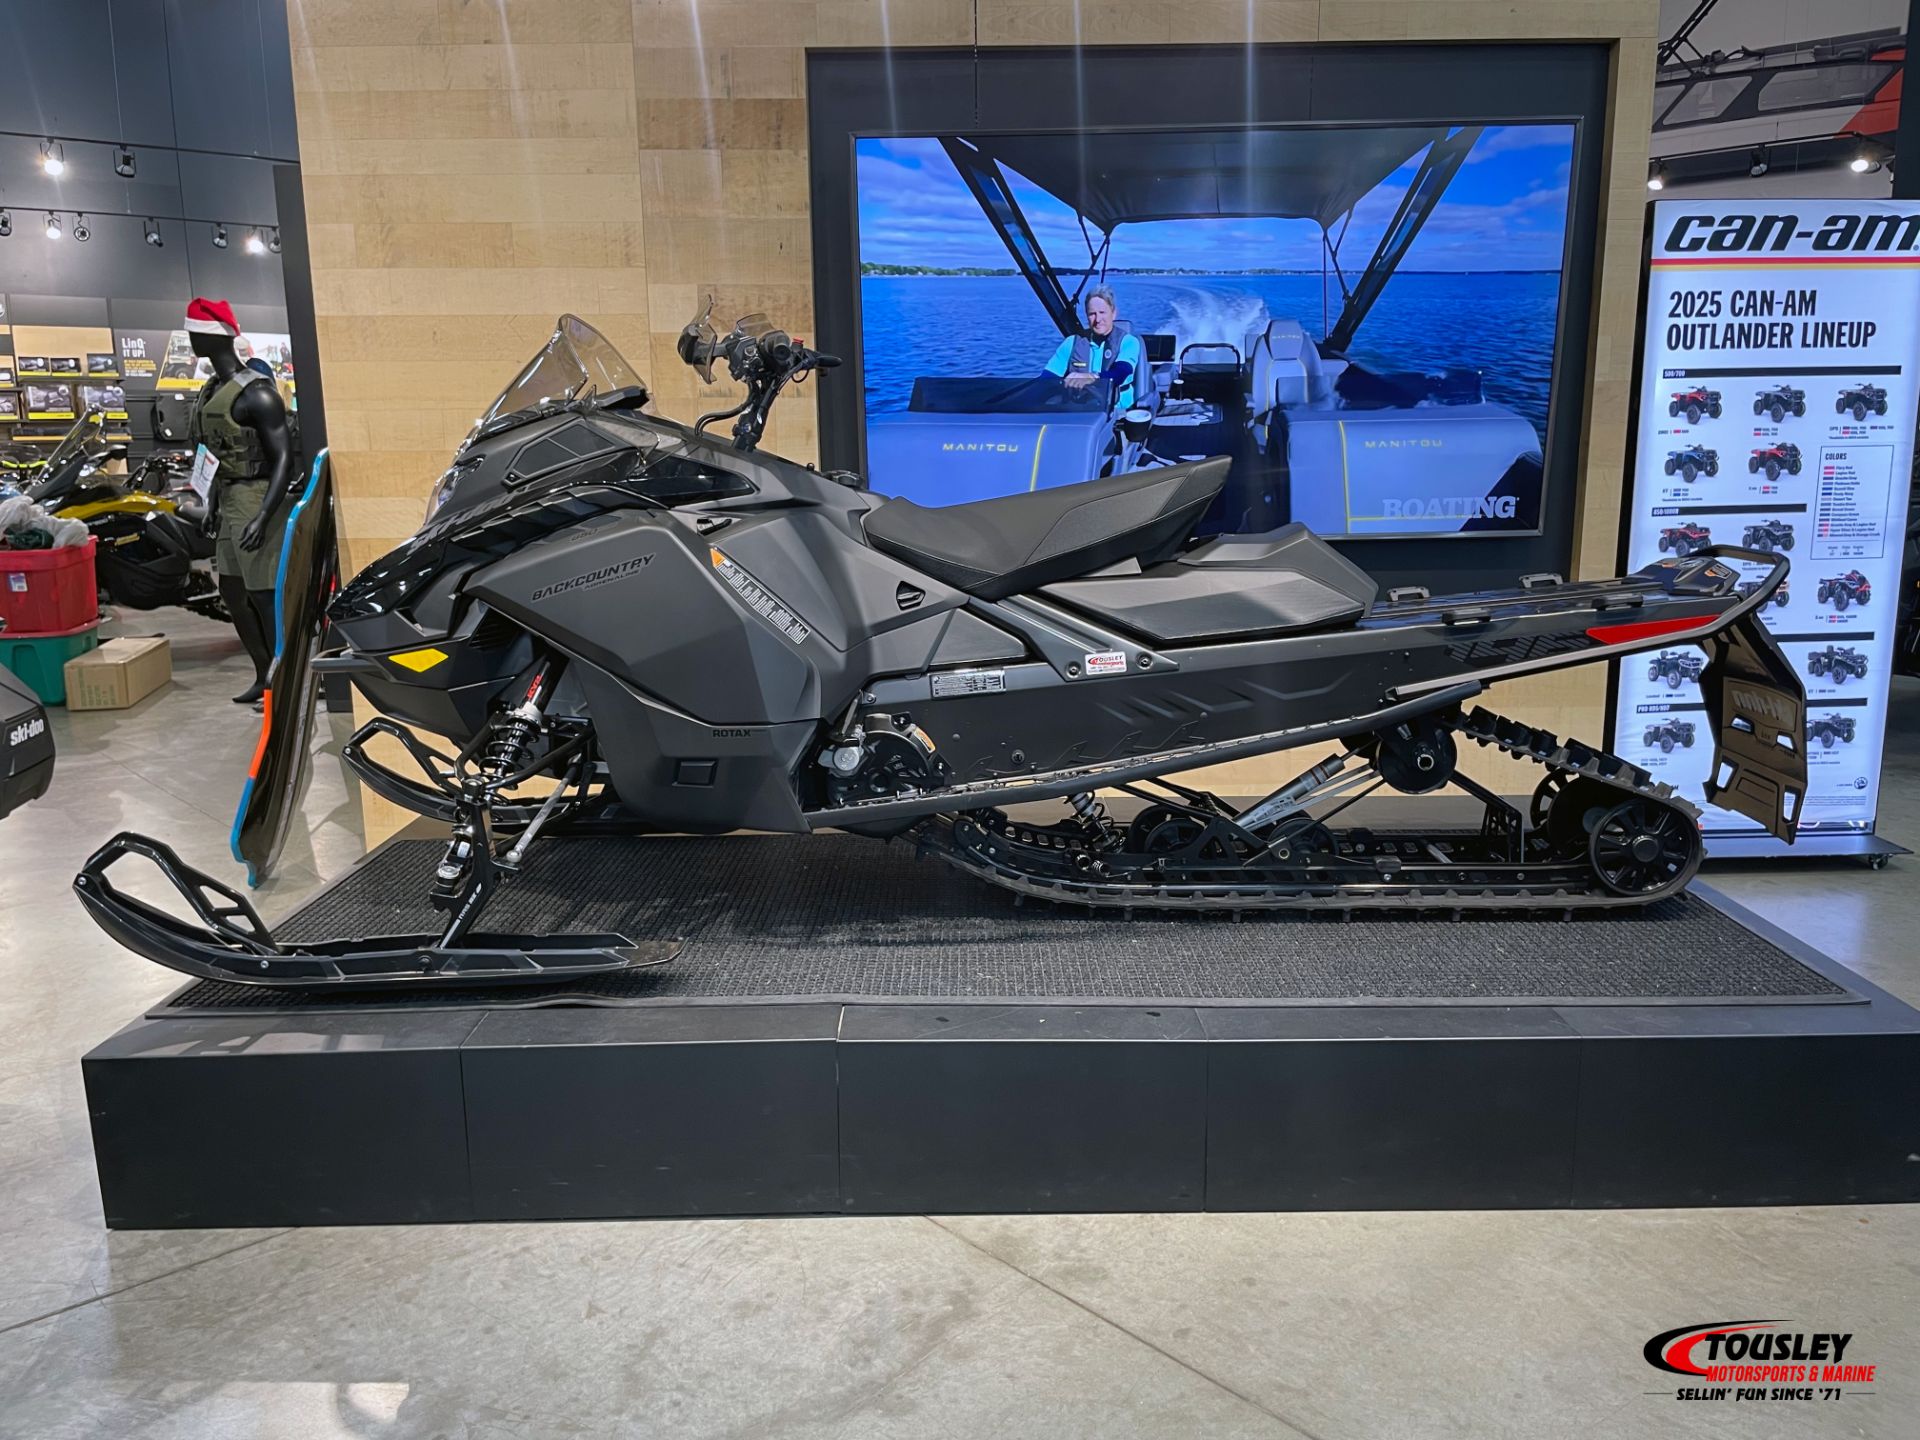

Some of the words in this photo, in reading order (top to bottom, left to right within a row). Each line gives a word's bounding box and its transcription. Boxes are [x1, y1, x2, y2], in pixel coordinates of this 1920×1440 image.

[1664, 215, 1920, 252] can-am
[1668, 291, 1722, 318] 2025
[1730, 290, 1817, 317] CAN-AM
[1667, 322, 1794, 351] OUTLANDER
[1801, 321, 1877, 348] LINEUP
[942, 443, 1018, 452] MANITOU
[1365, 439, 1442, 448] MANITOU
[1382, 495, 1516, 519] BOATING
[531, 554, 655, 601] BACKCOUNTRY
[10, 719, 44, 746] ski-doo
[712, 729, 751, 737] ROTAX
